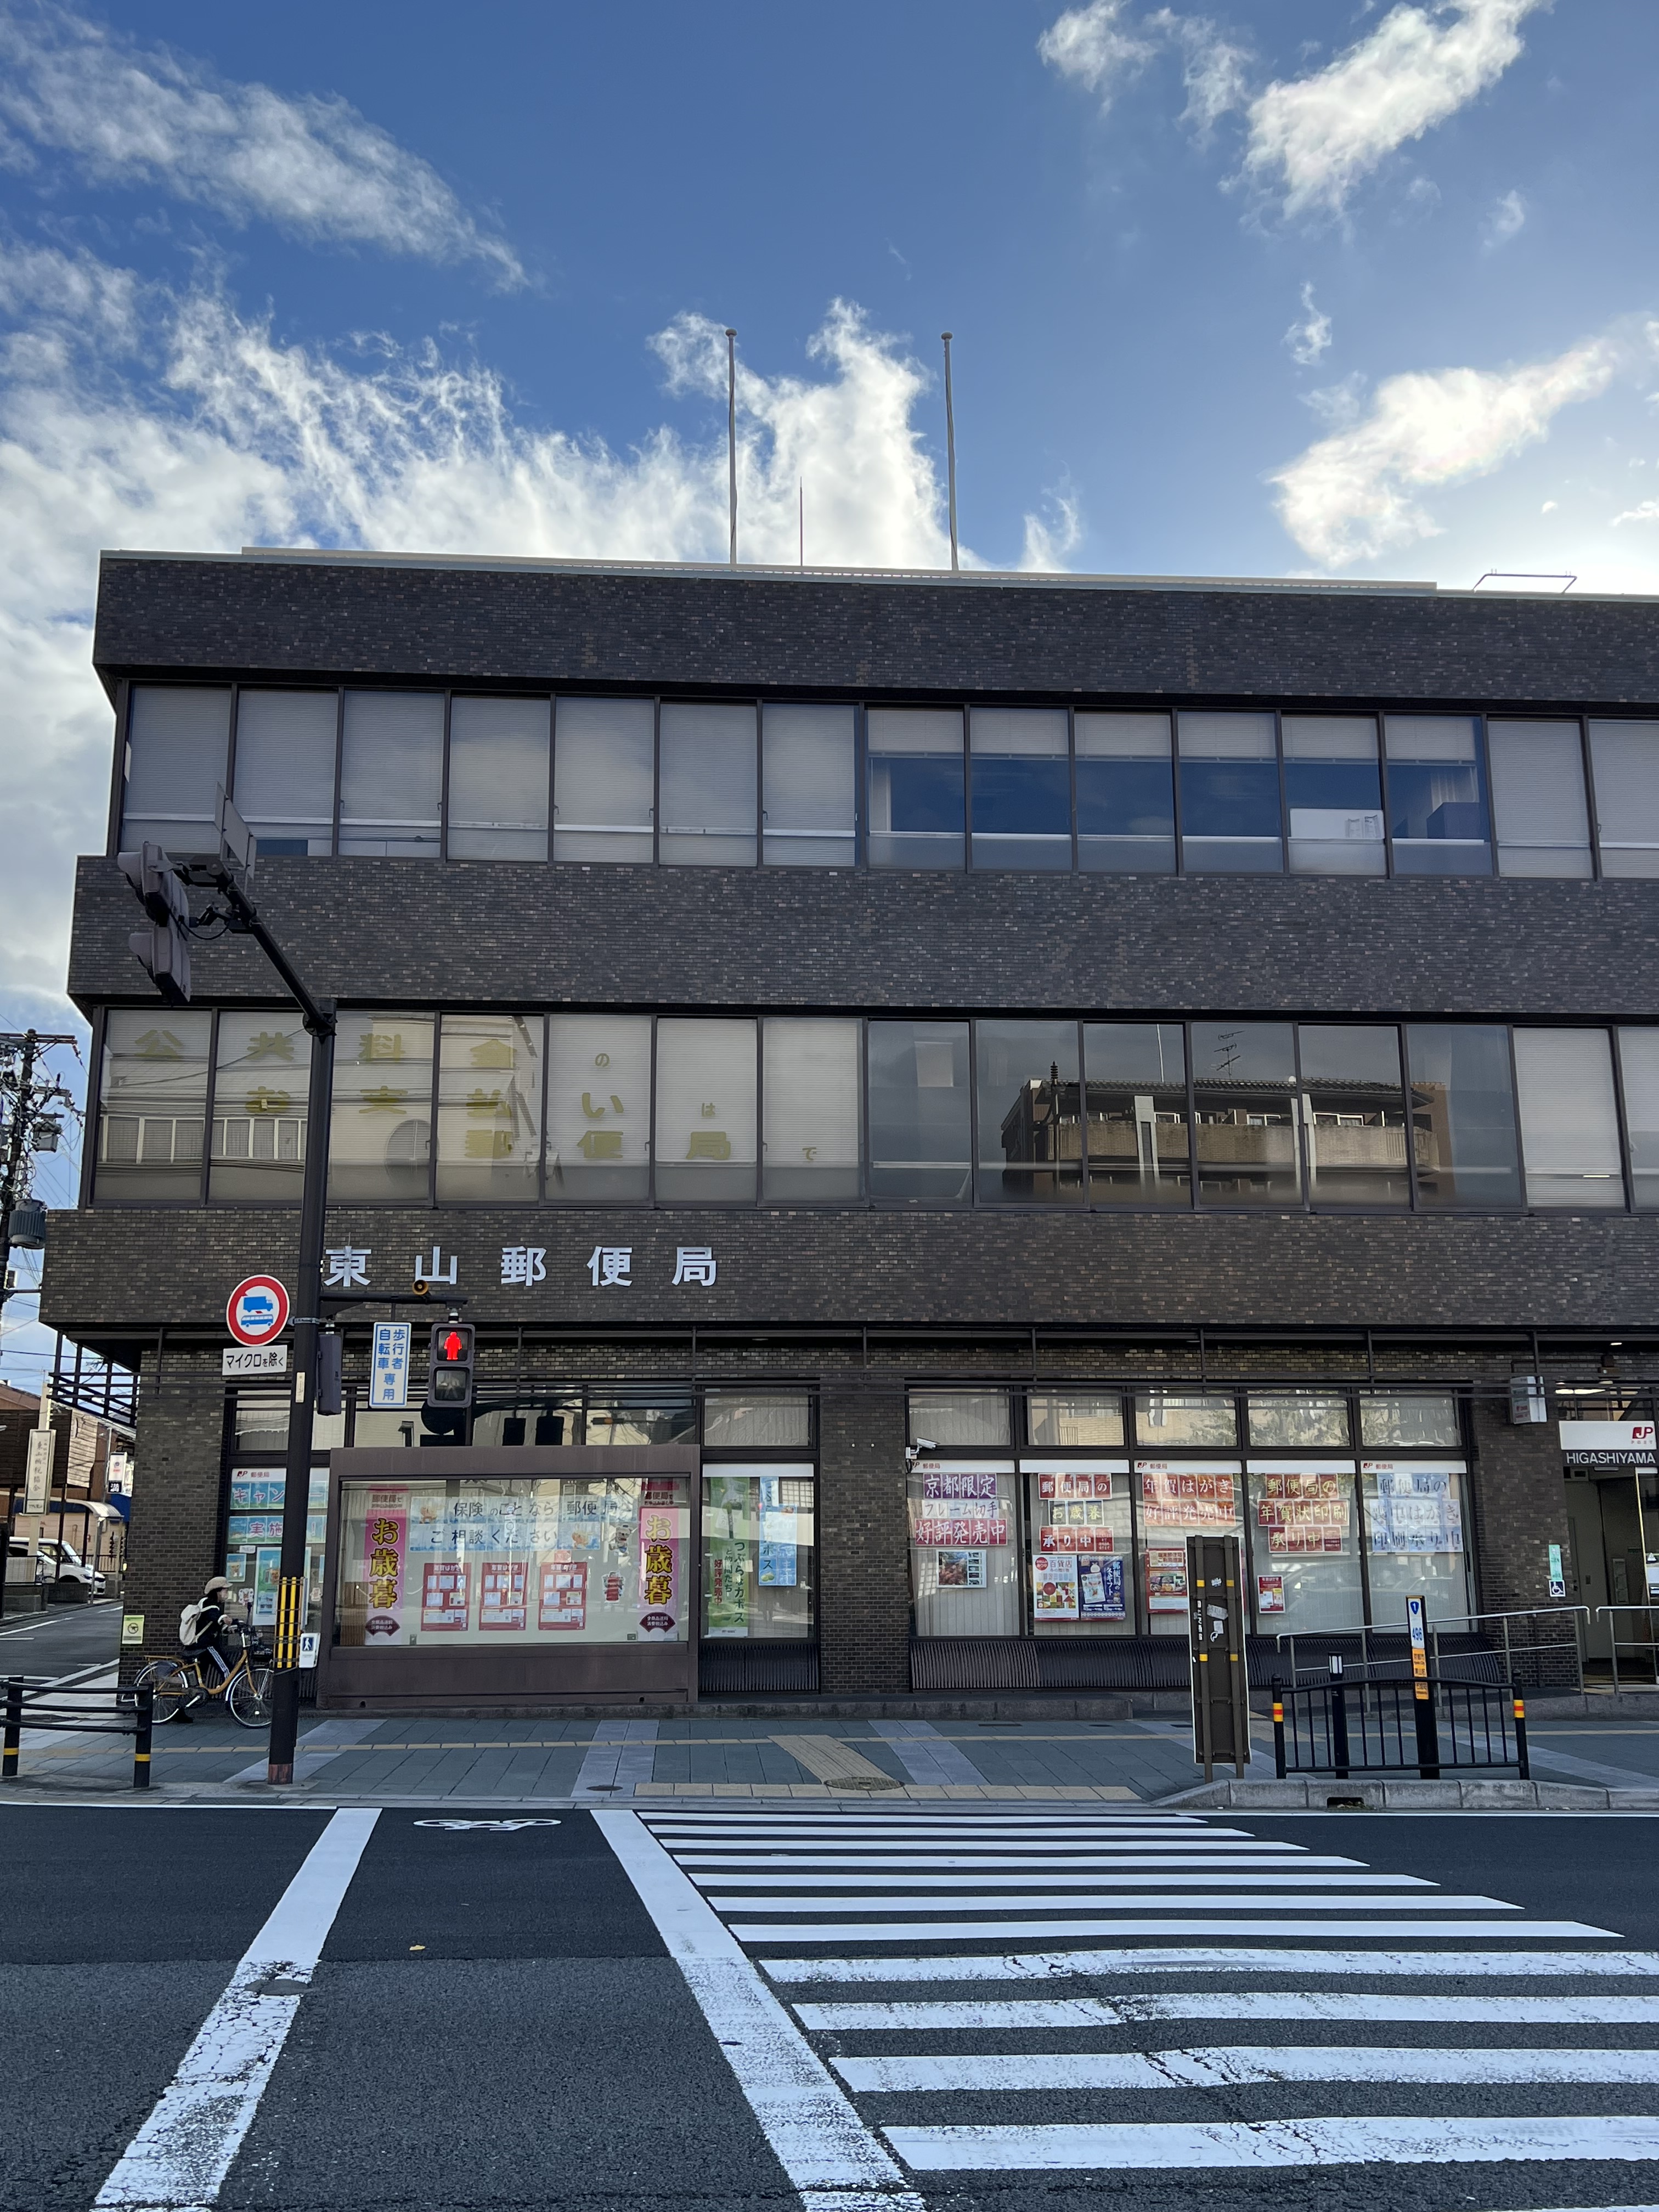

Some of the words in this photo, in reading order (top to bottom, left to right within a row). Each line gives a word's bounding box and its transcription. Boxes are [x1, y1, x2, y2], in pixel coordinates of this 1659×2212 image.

[324, 1245, 716, 1287] 東山郵便局
[377, 1328, 391, 1370] 自転車
[391, 1329, 405, 1370] 歩行者
[226, 1352, 284, 1369] マイクロを除く
[383, 1373, 396, 1401] 専用
[1566, 1452, 1656, 1464] HIGASHIYAMA
[925, 1474, 997, 1499] 京都限定
[1042, 1481, 1107, 1493] 郵便局の
[1144, 1478, 1229, 1493] 年賀はがき
[1267, 1478, 1335, 1496] 郵便局の
[924, 1500, 997, 1519] フレーム切手
[1052, 1505, 1102, 1520] お歳暮
[1146, 1504, 1233, 1520] 好評発売中
[1260, 1504, 1347, 1522] 年賀状印刷
[431, 1529, 558, 1545] ご相談ください
[915, 1520, 1006, 1545] 好評発売中
[1043, 1534, 1091, 1548] 承り中
[1271, 1531, 1320, 1548] 承り中
[369, 1517, 399, 1609] お歳暮
[644, 1514, 673, 1605] お歳暮
[1413, 1602, 1417, 1611] 1
[1412, 1627, 1423, 1641] 496
